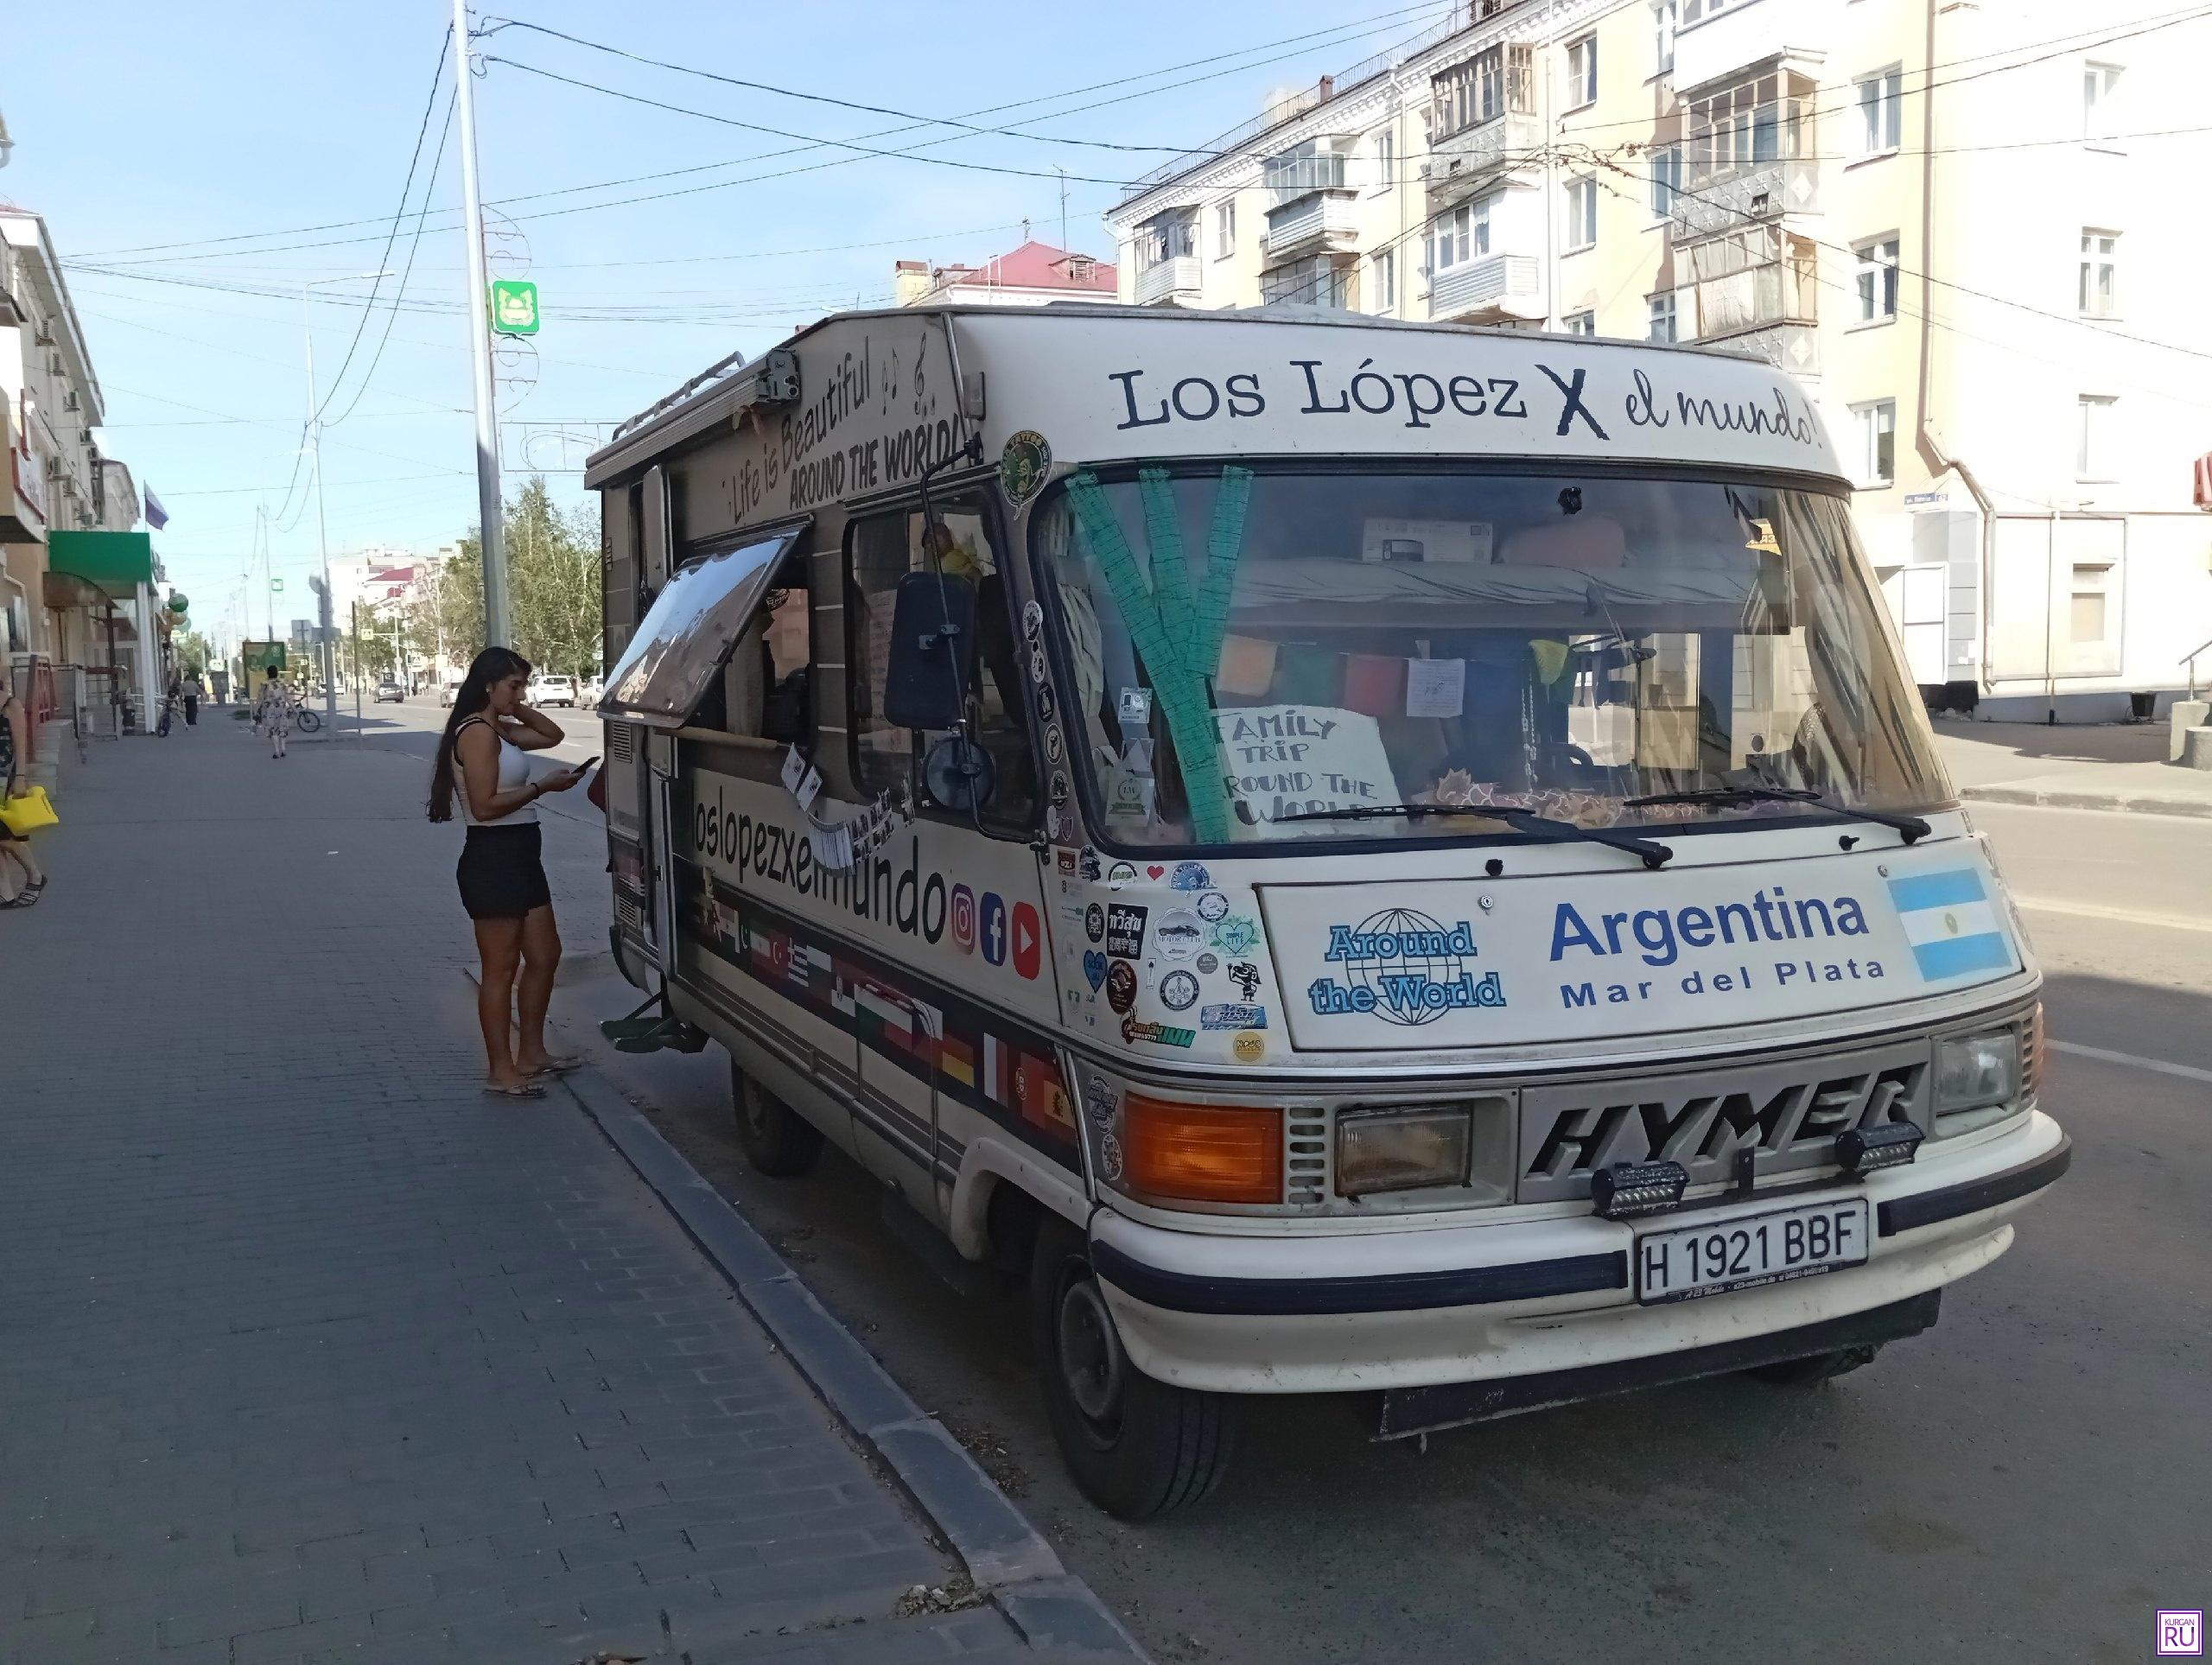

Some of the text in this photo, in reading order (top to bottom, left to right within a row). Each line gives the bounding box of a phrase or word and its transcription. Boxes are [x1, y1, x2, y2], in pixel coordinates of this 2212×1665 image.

[764, 442, 779, 493] is
[782, 335, 871, 473] Beautiful
[1109, 358, 1822, 449] Los López X el mundo!
[789, 452, 844, 510] AROUND
[849, 439, 878, 491] THE
[1321, 773, 1378, 799] THE
[1325, 921, 1478, 962] Around
[1549, 887, 1870, 967] Argentina
[1307, 972, 1507, 1015] the World
[1560, 958, 1885, 1008] Mar del Plata
[1525, 1061, 1928, 1178] HYMER
[1646, 1210, 1856, 1290] H 1921 BBF
